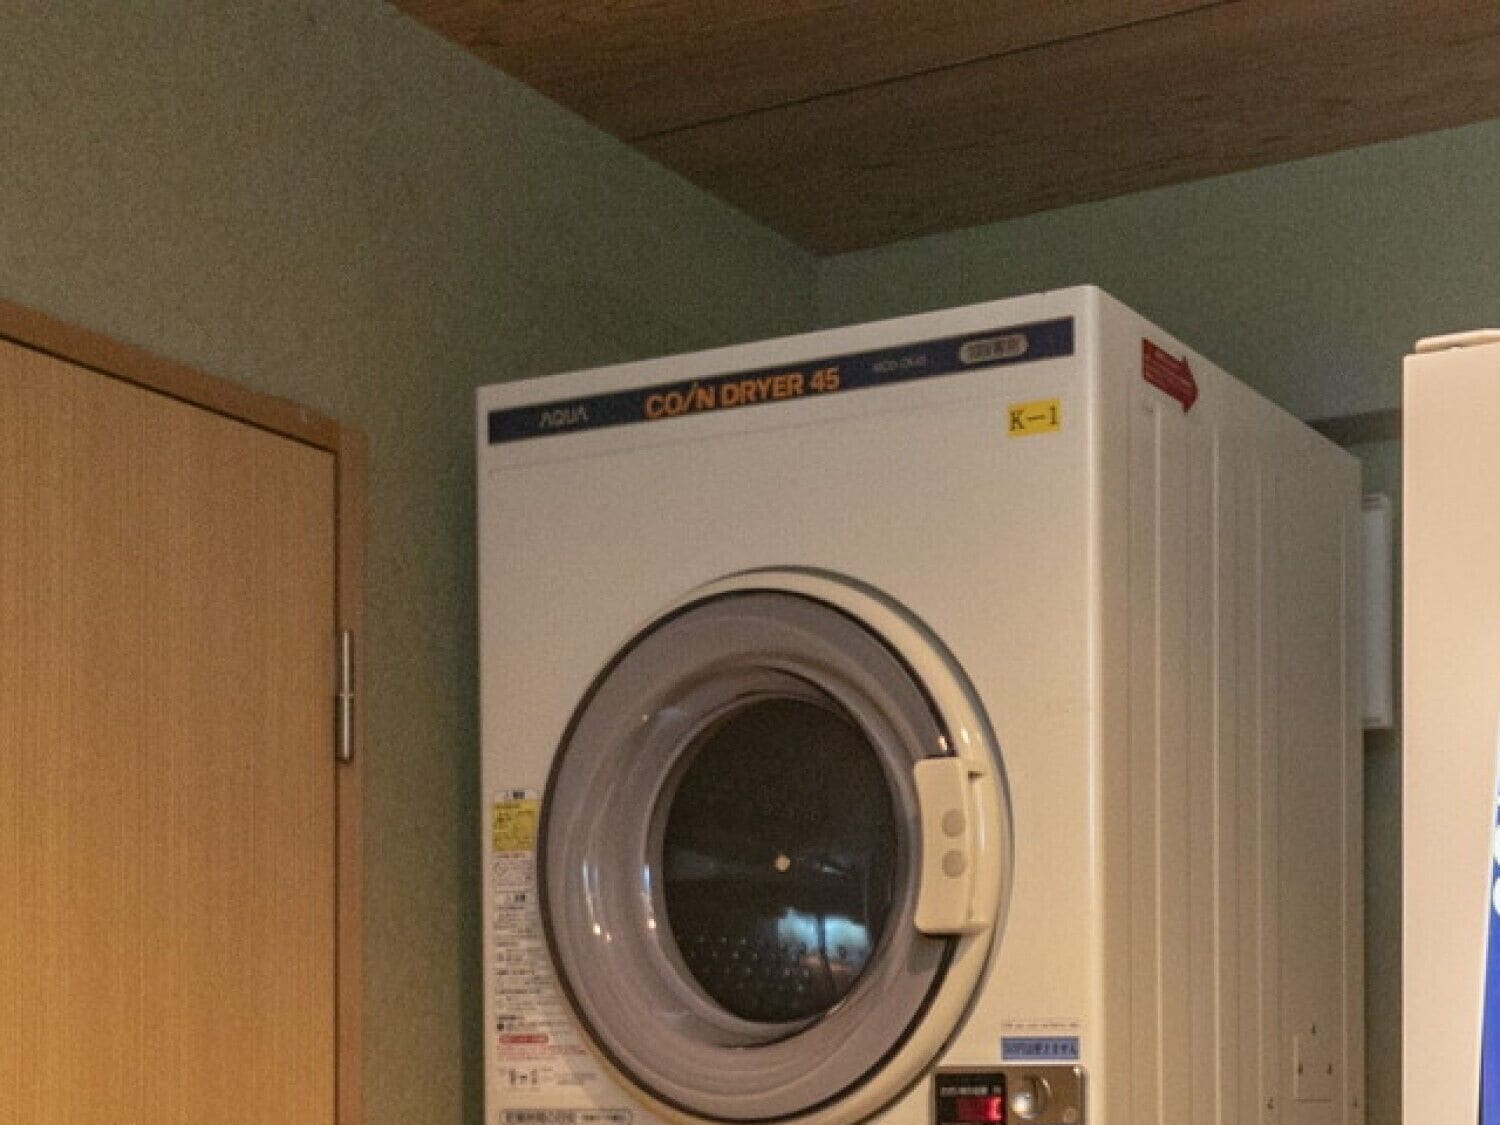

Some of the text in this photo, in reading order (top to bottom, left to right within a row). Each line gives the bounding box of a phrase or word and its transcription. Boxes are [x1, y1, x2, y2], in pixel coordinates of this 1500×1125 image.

[538, 405, 589, 428] AQUA
[720, 373, 805, 409] DRYER
[808, 367, 841, 392] 45
[1009, 403, 1059, 433] K-1
